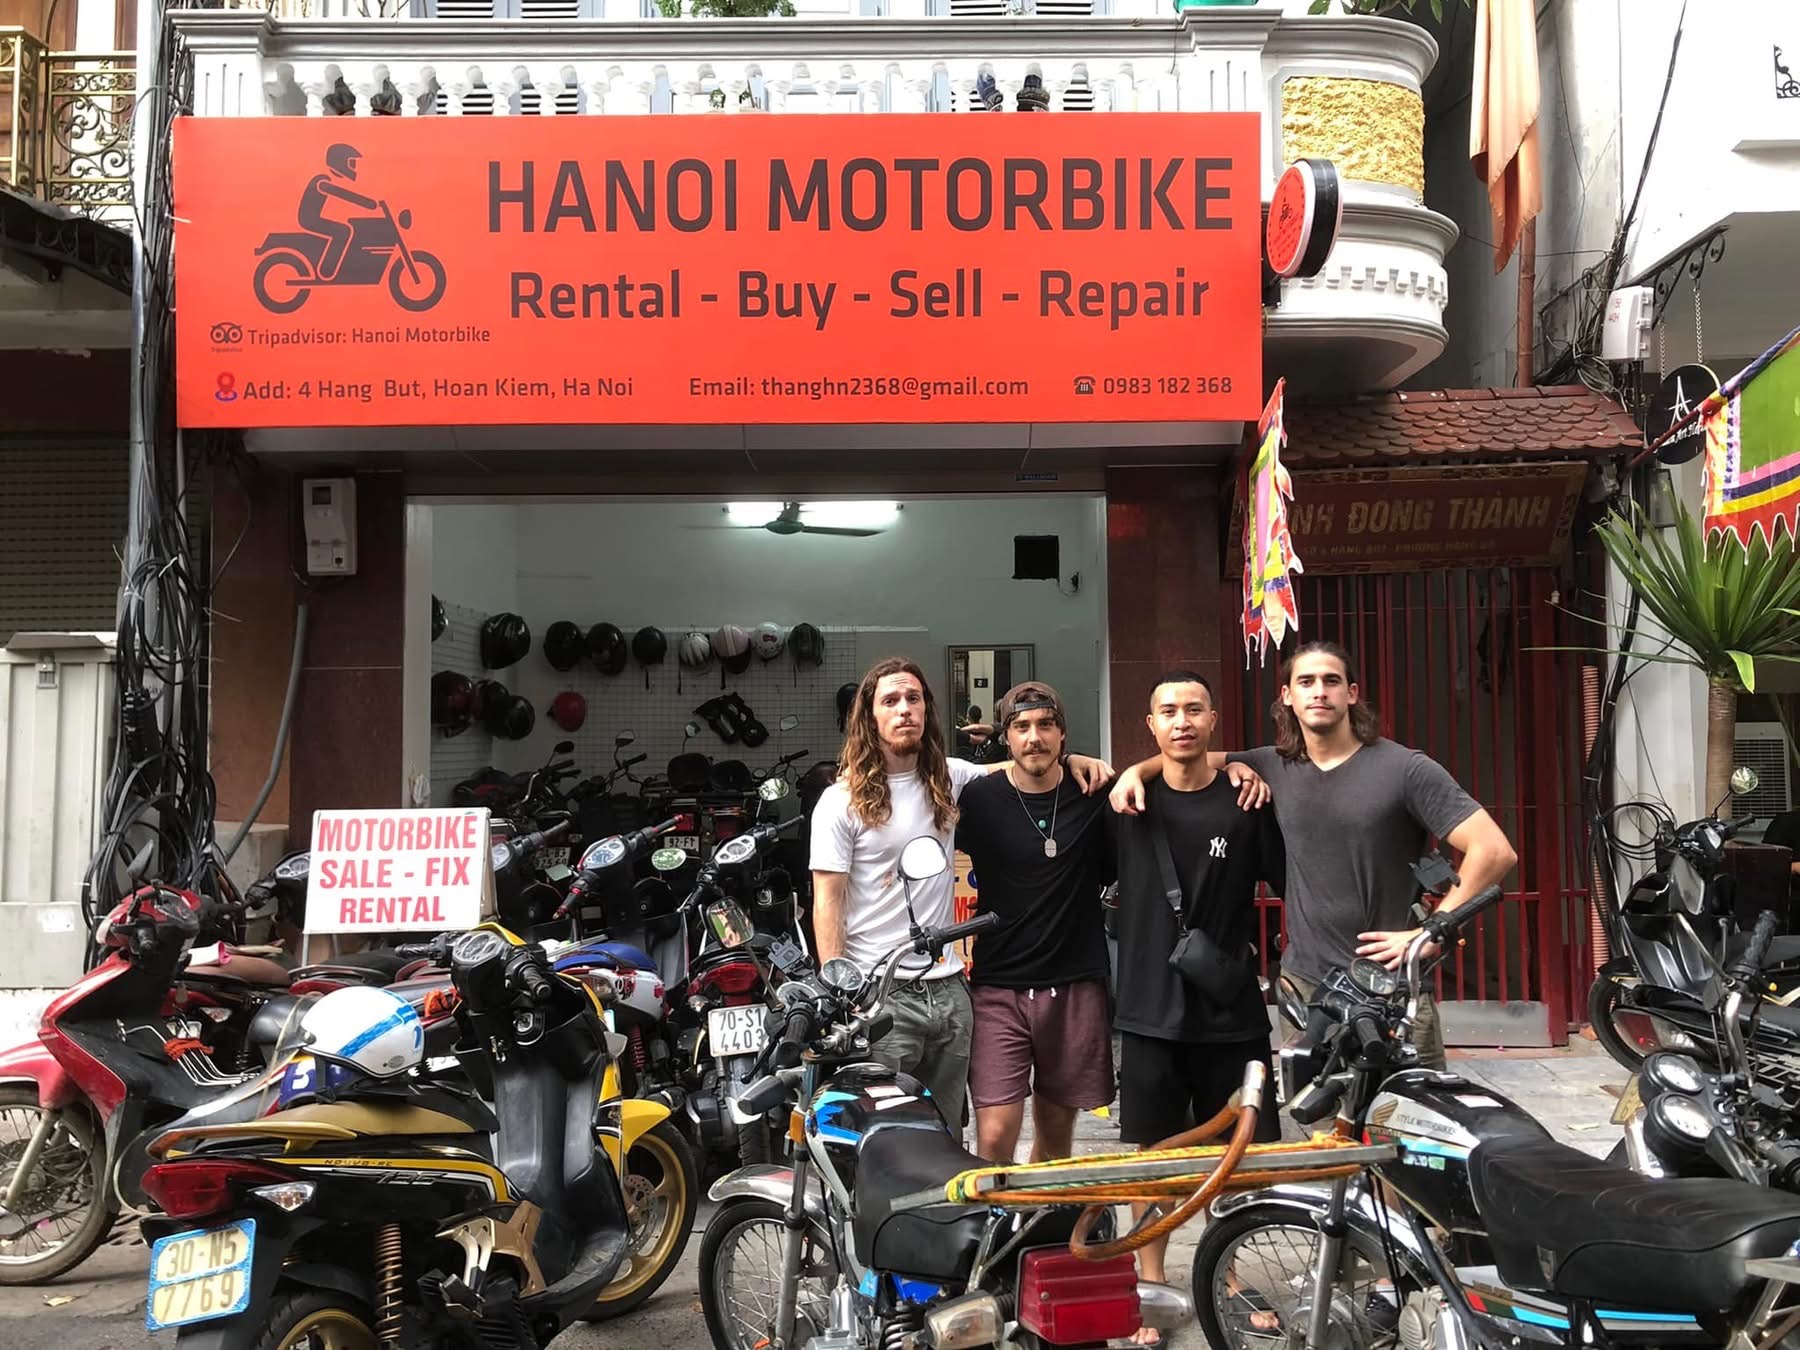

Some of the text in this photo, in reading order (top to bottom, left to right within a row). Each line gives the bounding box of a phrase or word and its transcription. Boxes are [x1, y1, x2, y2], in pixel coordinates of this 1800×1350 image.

[488, 158, 738, 233] HANOI
[768, 157, 1233, 232] MOTORBIKE
[511, 268, 681, 319] Rental
[738, 270, 837, 331] Buy
[890, 267, 982, 318] Sell
[1039, 267, 1210, 331] Repair
[248, 326, 491, 349] Tripadvisor: Hanoi Motorbike
[243, 377, 633, 403] Add: 4 Hang But, Hoan Kiem, Ha Noi
[689, 376, 1029, 401] Email: thanghn2368@gmail.com
[1103, 376, 1233, 395] 0983 182 368
[318, 815, 478, 852] MOTORBIKE
[319, 859, 393, 890] SALE
[425, 856, 471, 887] FIX
[339, 895, 446, 924] RENTAL
[718, 1006, 762, 1031] 70-S1
[166, 1228, 240, 1278] 30-N5
[161, 1272, 235, 1322] 7769
